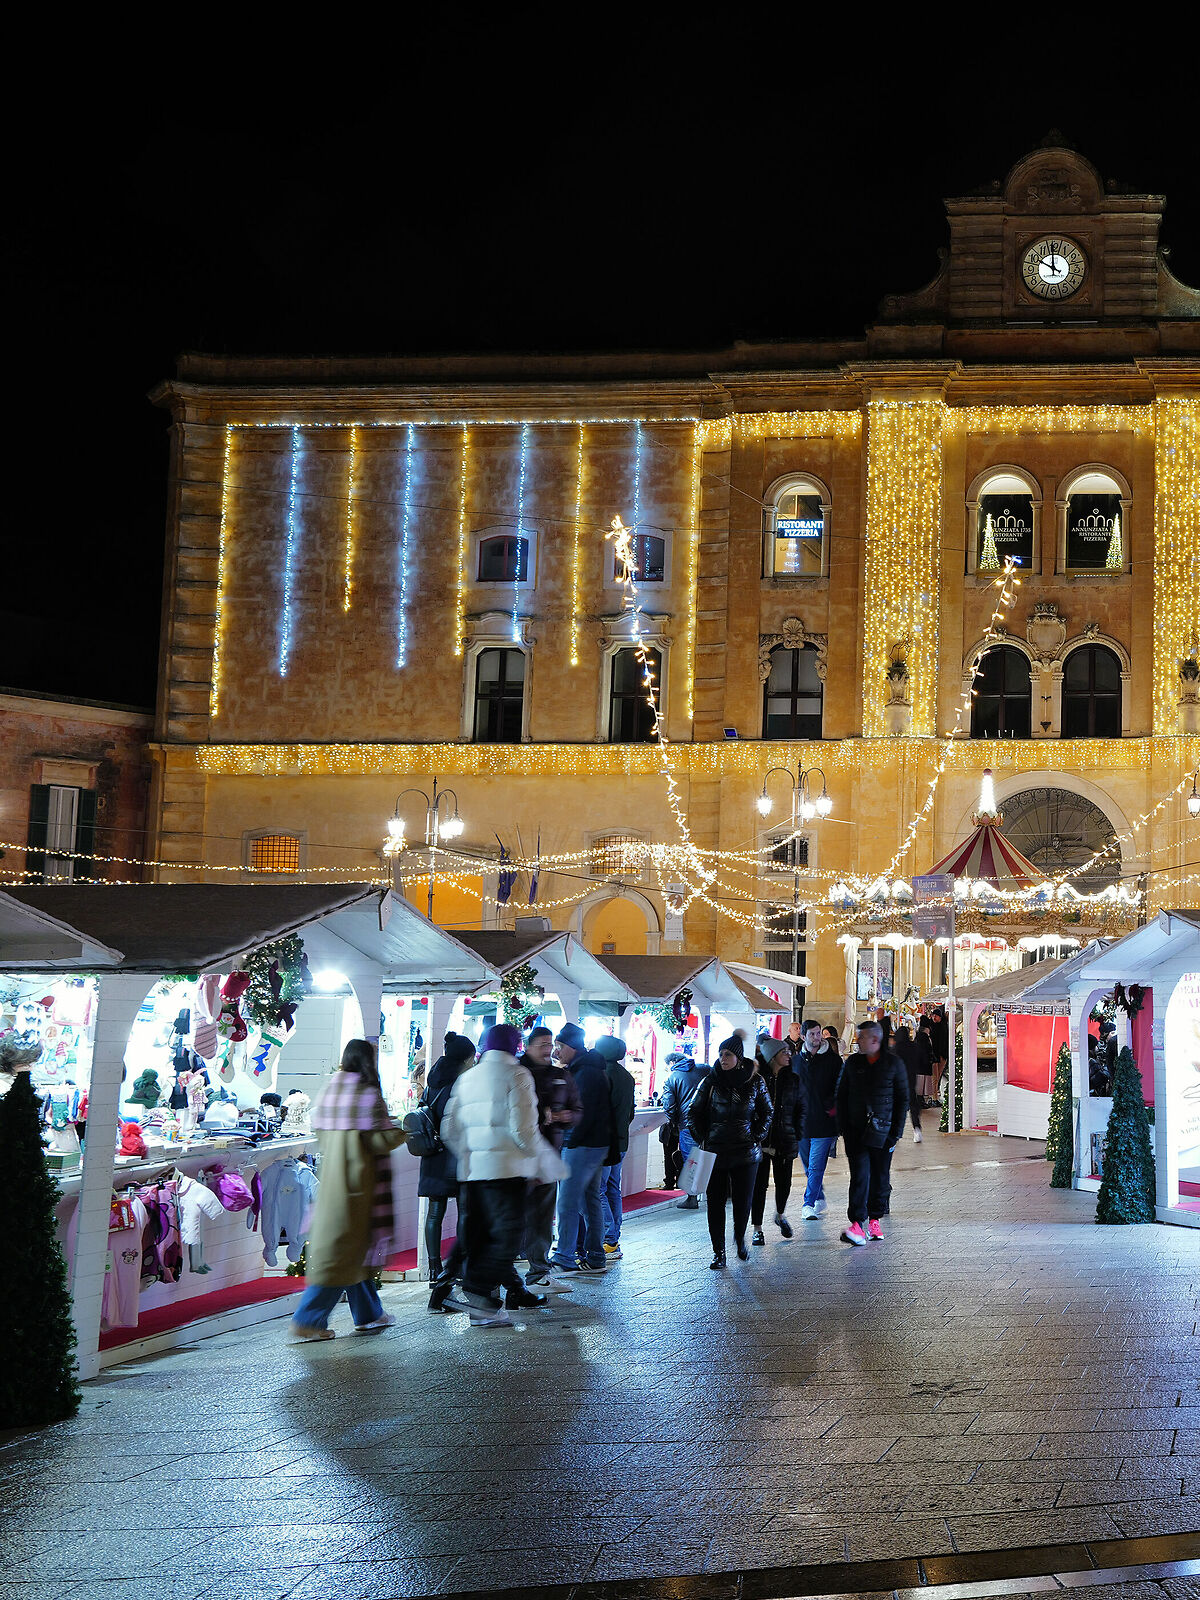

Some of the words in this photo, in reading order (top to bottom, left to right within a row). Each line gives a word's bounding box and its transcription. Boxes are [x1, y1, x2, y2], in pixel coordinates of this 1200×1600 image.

[1040, 246, 1046, 255] 11
[1051, 243, 1058, 252] 12
[1063, 246, 1066, 255] 1
[1031, 254, 1039, 263] 10
[1071, 253, 1077, 262] 2
[1028, 265, 1034, 274] 9
[1074, 264, 1080, 273] 3
[1031, 276, 1037, 285] 8
[1069, 275, 1075, 284] 4
[1040, 284, 1046, 293] 7
[1050, 286, 1057, 295] 6
[1062, 284, 1068, 293] 5
[783, 528, 820, 537] PIZZERIA
